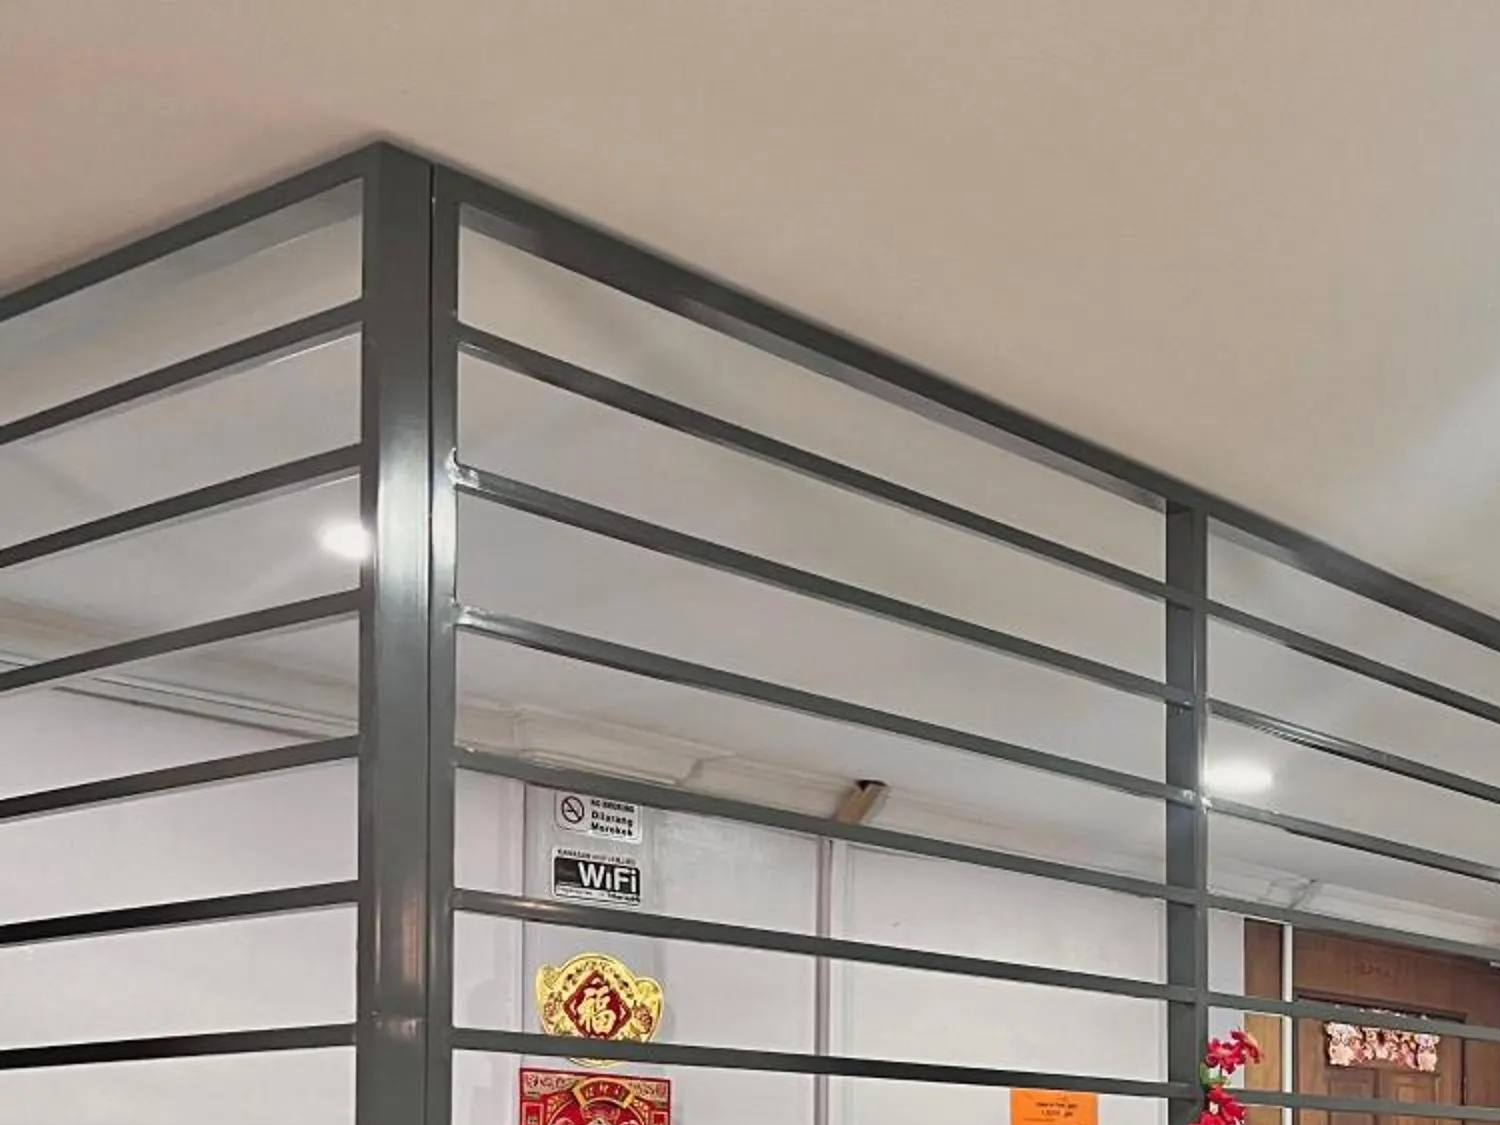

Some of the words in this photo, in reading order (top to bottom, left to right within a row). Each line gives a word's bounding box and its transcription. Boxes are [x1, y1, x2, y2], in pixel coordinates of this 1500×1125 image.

[591, 810, 633, 828] Dilarang
[578, 861, 638, 893] WiFi
[576, 985, 617, 1034] 福
